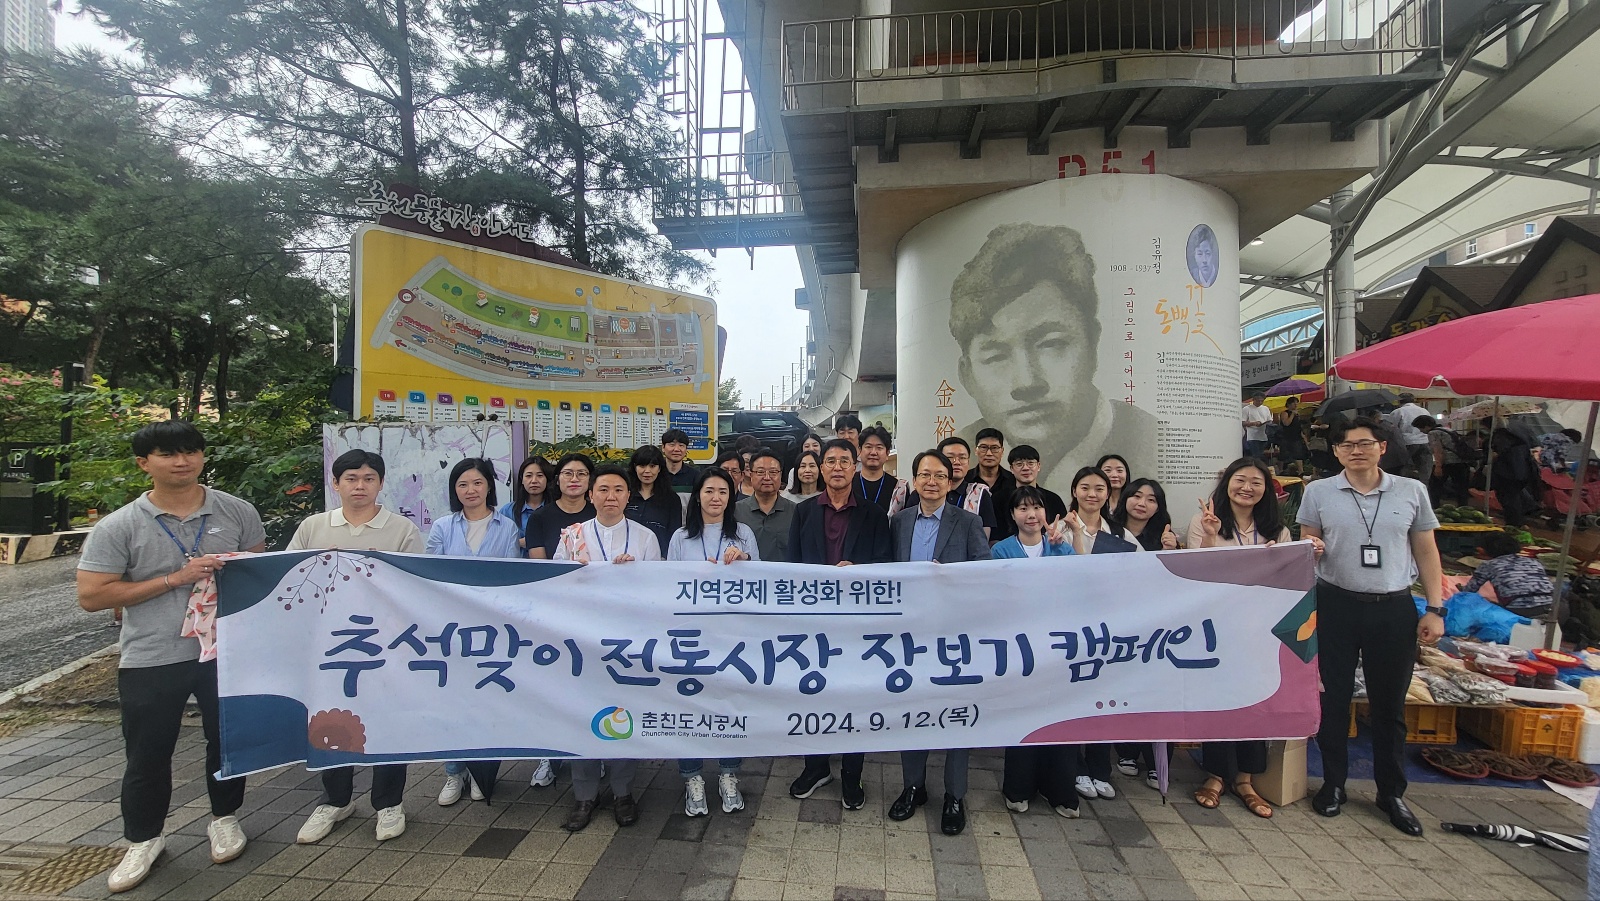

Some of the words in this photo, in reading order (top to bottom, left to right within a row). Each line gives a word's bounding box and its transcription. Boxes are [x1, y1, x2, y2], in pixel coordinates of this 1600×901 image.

[479, 213, 534, 242] 안내도
[1110, 264, 1127, 273] 1908
[1135, 264, 1151, 273] 1937
[1152, 237, 1163, 275] 김유정
[1123, 287, 1136, 342] 그림으로
[675, 578, 768, 606] 지역경제
[773, 578, 844, 606] 활성화
[848, 577, 902, 605] 위한!
[318, 613, 584, 698] 추석맞이
[599, 627, 843, 697] 전통시장
[861, 631, 1035, 694] 장보기
[1048, 617, 1221, 684] 캠페인
[641, 711, 748, 732] 춘천도시공사
[786, 712, 861, 737] 2024.
[869, 713, 891, 732] 9.
[901, 703, 981, 731] 12.(목)
